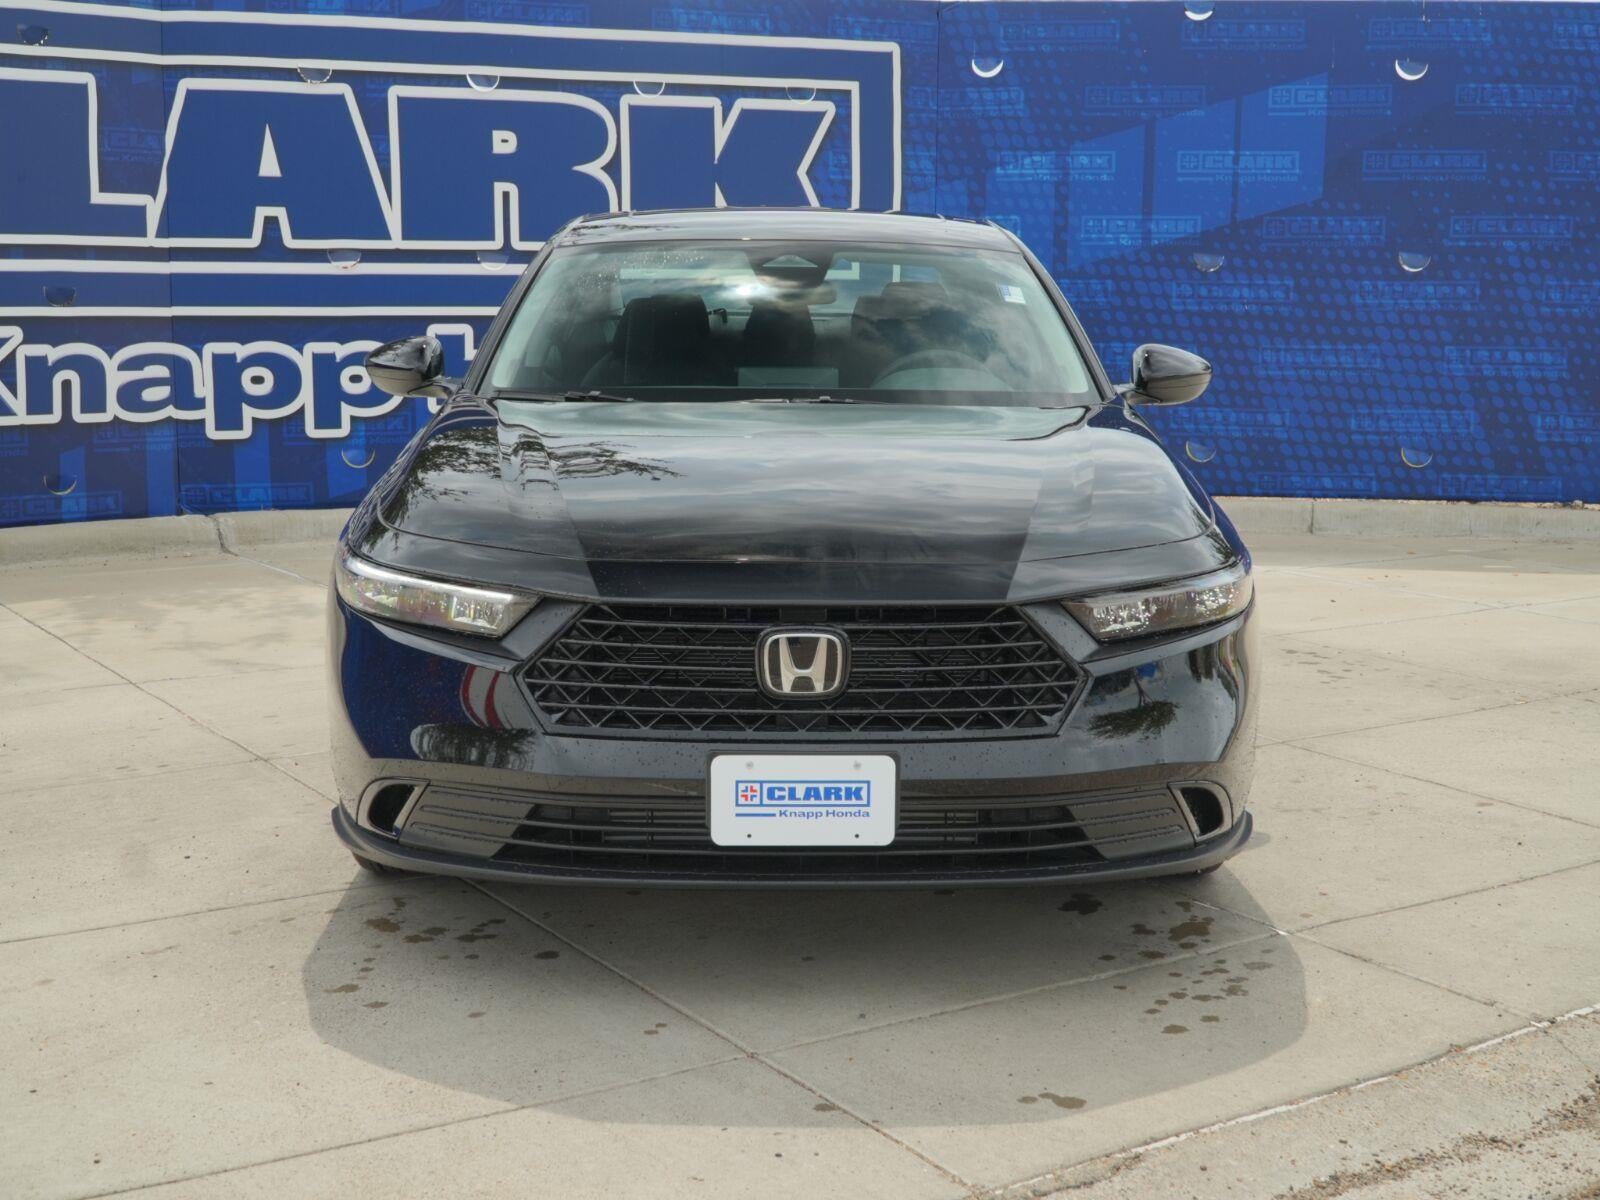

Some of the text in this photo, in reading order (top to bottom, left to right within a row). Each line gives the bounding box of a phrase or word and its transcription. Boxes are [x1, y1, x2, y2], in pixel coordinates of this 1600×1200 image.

[1204, 155, 1294, 169] CLARK
[0, 323, 402, 440] napp
[767, 786, 864, 801] CLARK
[779, 809, 870, 819] Knapp Honda
